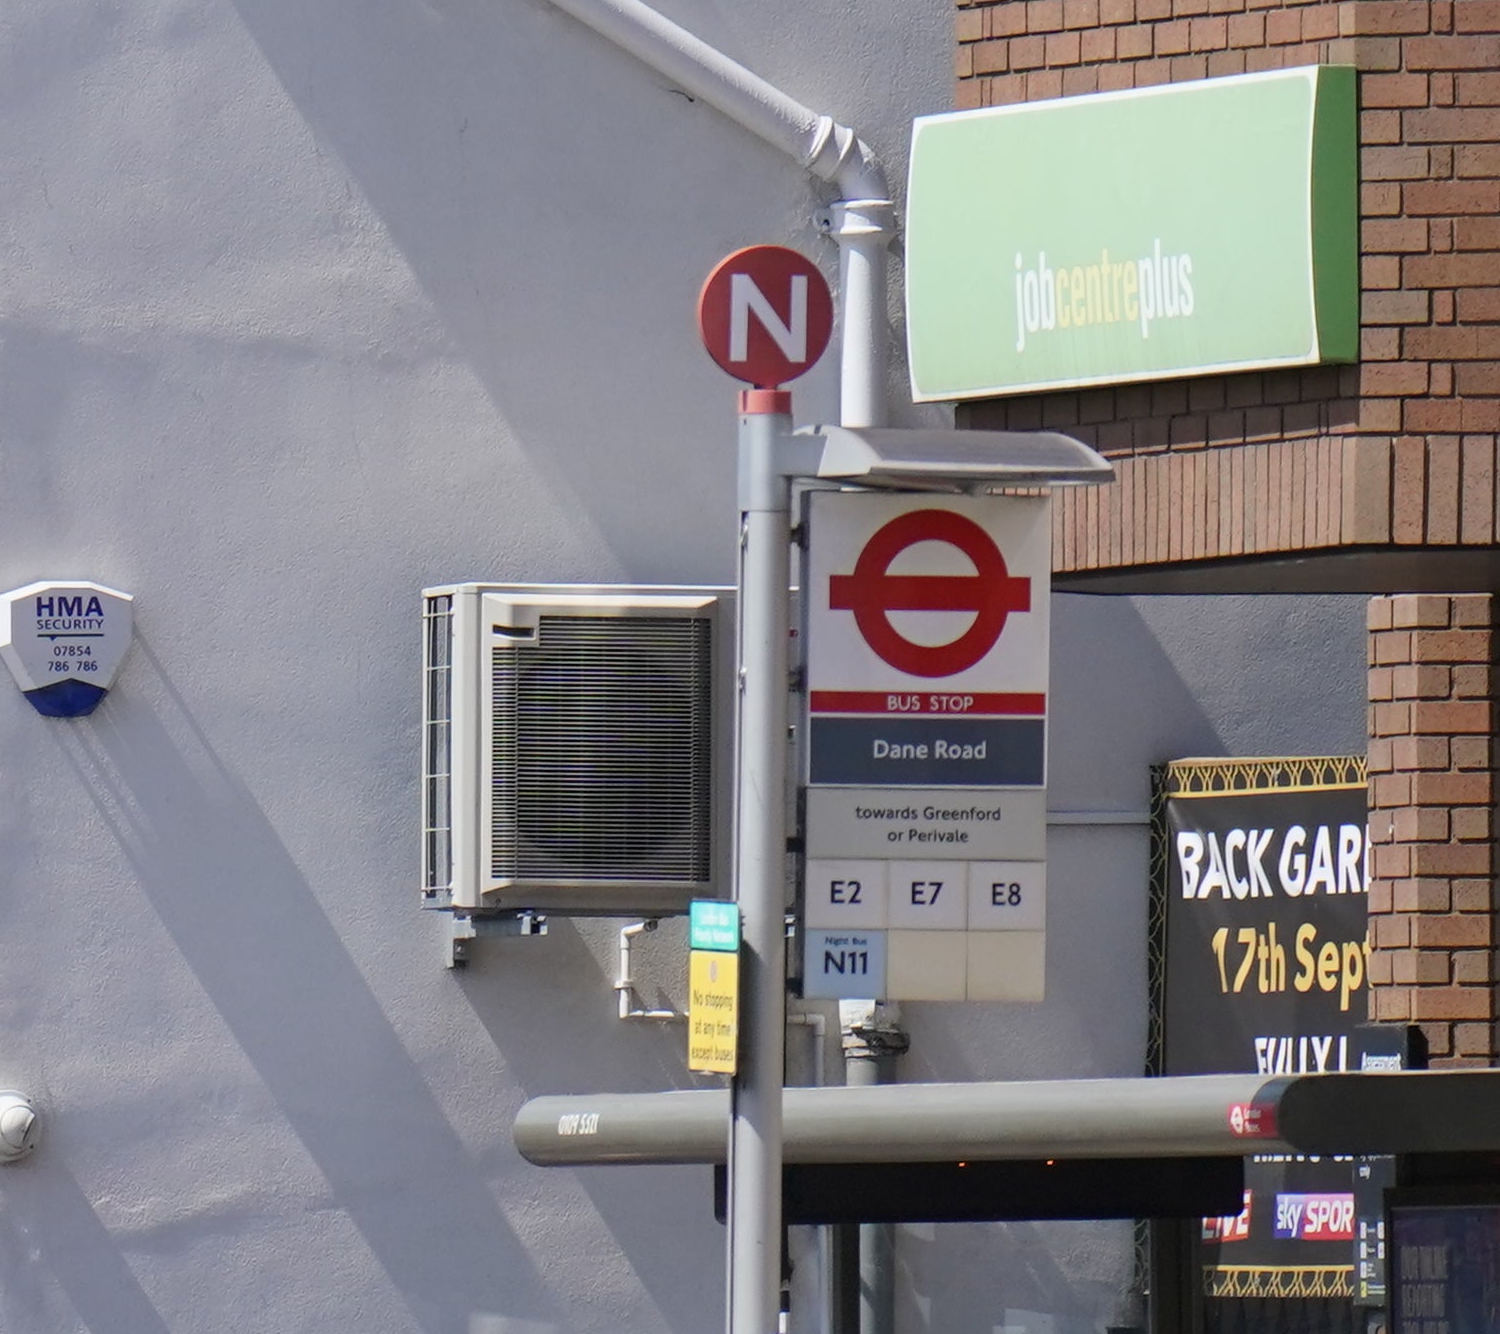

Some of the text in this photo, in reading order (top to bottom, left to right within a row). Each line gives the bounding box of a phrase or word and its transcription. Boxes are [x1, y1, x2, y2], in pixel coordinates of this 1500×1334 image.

[1015, 239, 1194, 353] jobcentreplus
[729, 273, 808, 363] N
[36, 596, 104, 617] HMA
[37, 619, 104, 630] SECURITY
[53, 646, 91, 656] 07854
[48, 661, 98, 672] 786 786
[887, 696, 974, 712] BUS STOP
[873, 739, 987, 760] Dane Road
[856, 806, 1002, 821] towards Greenford
[888, 828, 969, 843] or Perivale
[1177, 828, 1274, 900] BACK
[831, 880, 861, 904] E2
[911, 881, 943, 905] E7
[992, 882, 1022, 906] E8
[825, 937, 867, 947] Night Bus
[824, 951, 868, 975] N11
[1211, 922, 1286, 994] 17th
[705, 991, 733, 1012] stopping
[1277, 1197, 1303, 1237] sky
